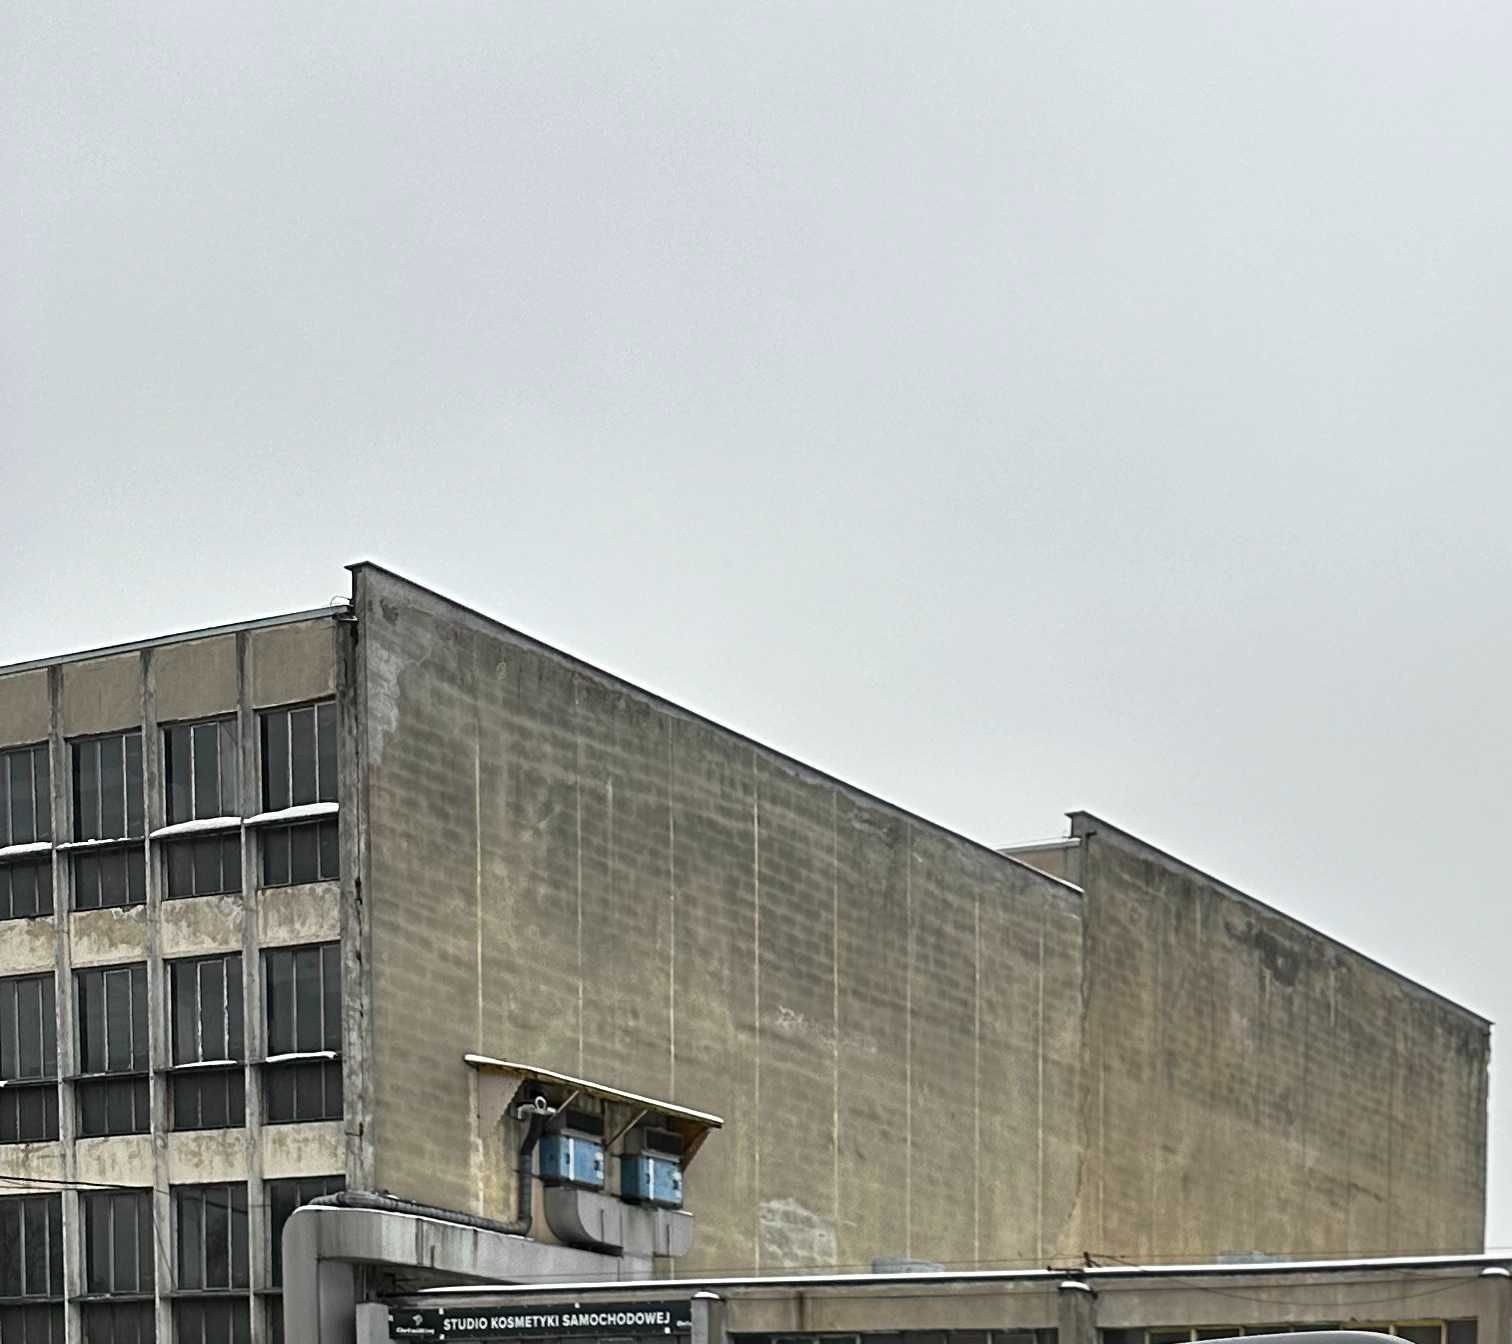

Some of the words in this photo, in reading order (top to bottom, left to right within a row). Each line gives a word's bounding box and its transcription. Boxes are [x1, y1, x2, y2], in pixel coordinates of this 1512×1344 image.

[443, 1317, 488, 1331] STUDIO
[491, 1314, 560, 1329] KOSMETYKI
[562, 1311, 670, 1326] SAMOCHODOWEJ
